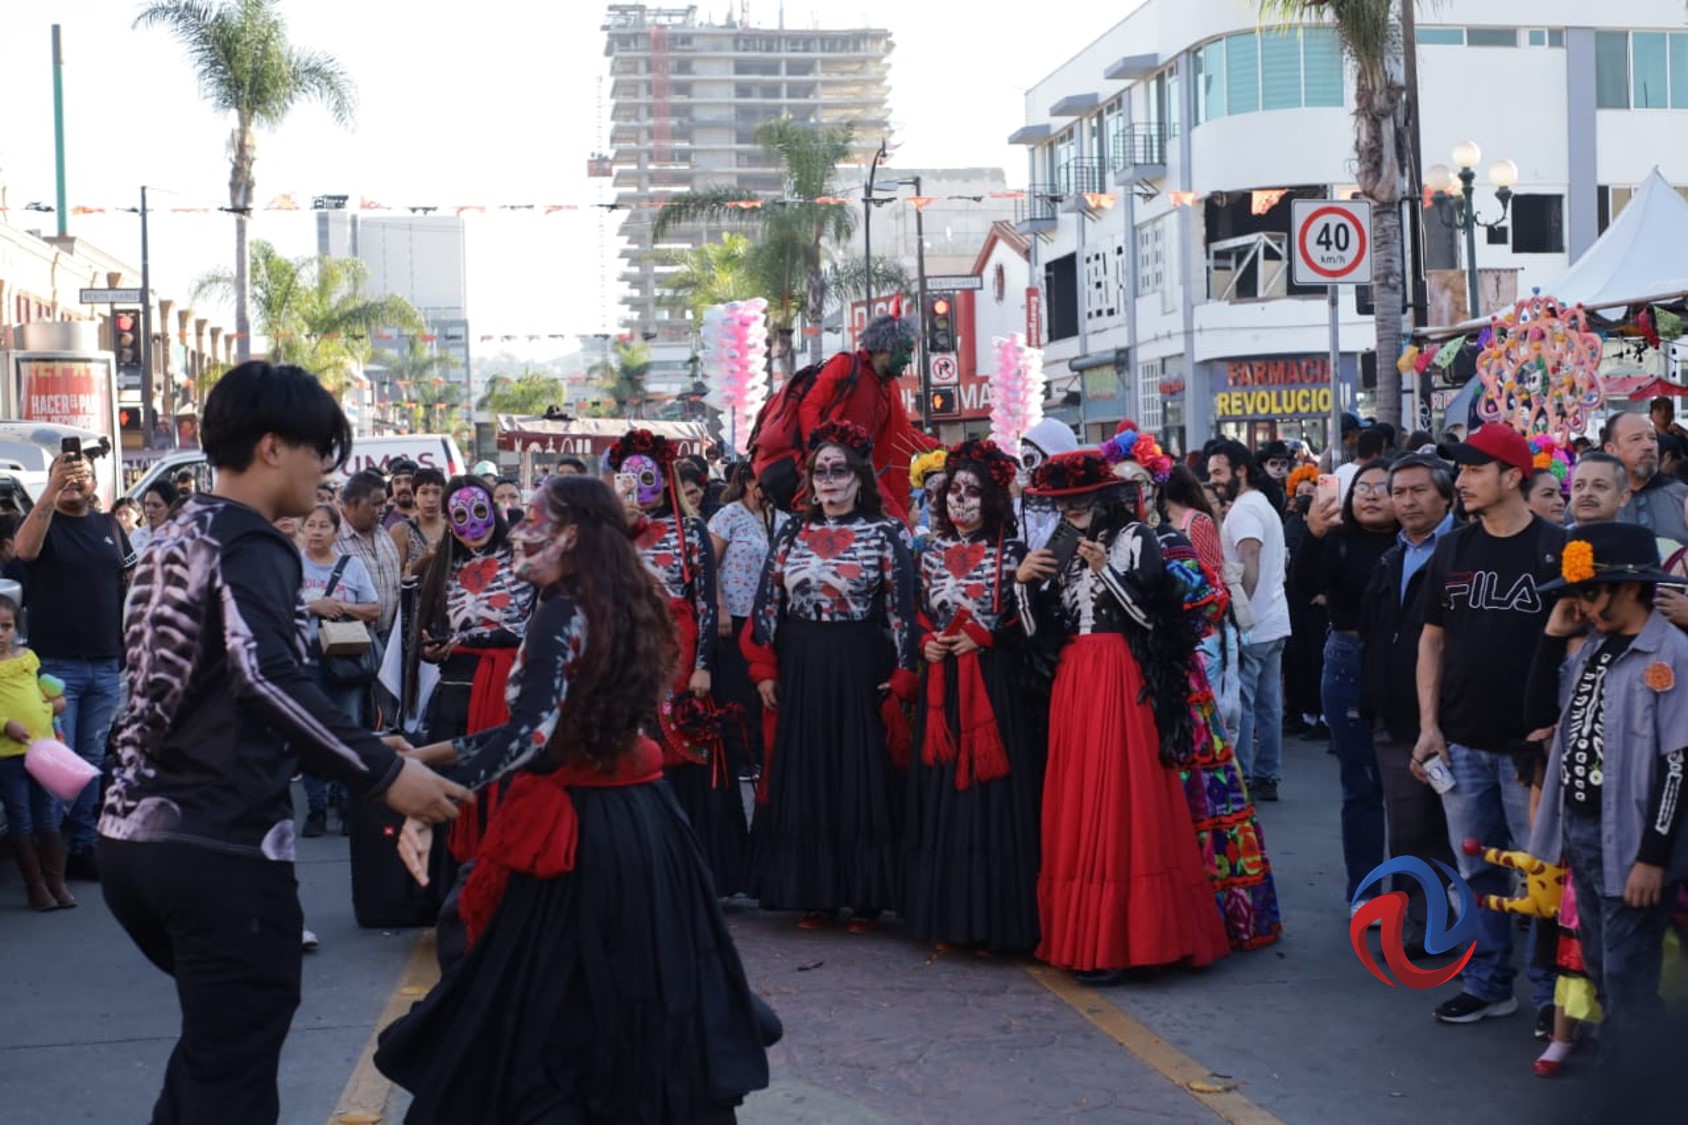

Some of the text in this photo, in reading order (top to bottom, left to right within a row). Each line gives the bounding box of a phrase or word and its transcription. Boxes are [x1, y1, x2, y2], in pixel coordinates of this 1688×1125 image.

[1316, 223, 1350, 252] 40
[1321, 255, 1346, 264] km/h
[31, 394, 69, 414] HACER
[1443, 569, 1542, 613] FILA
